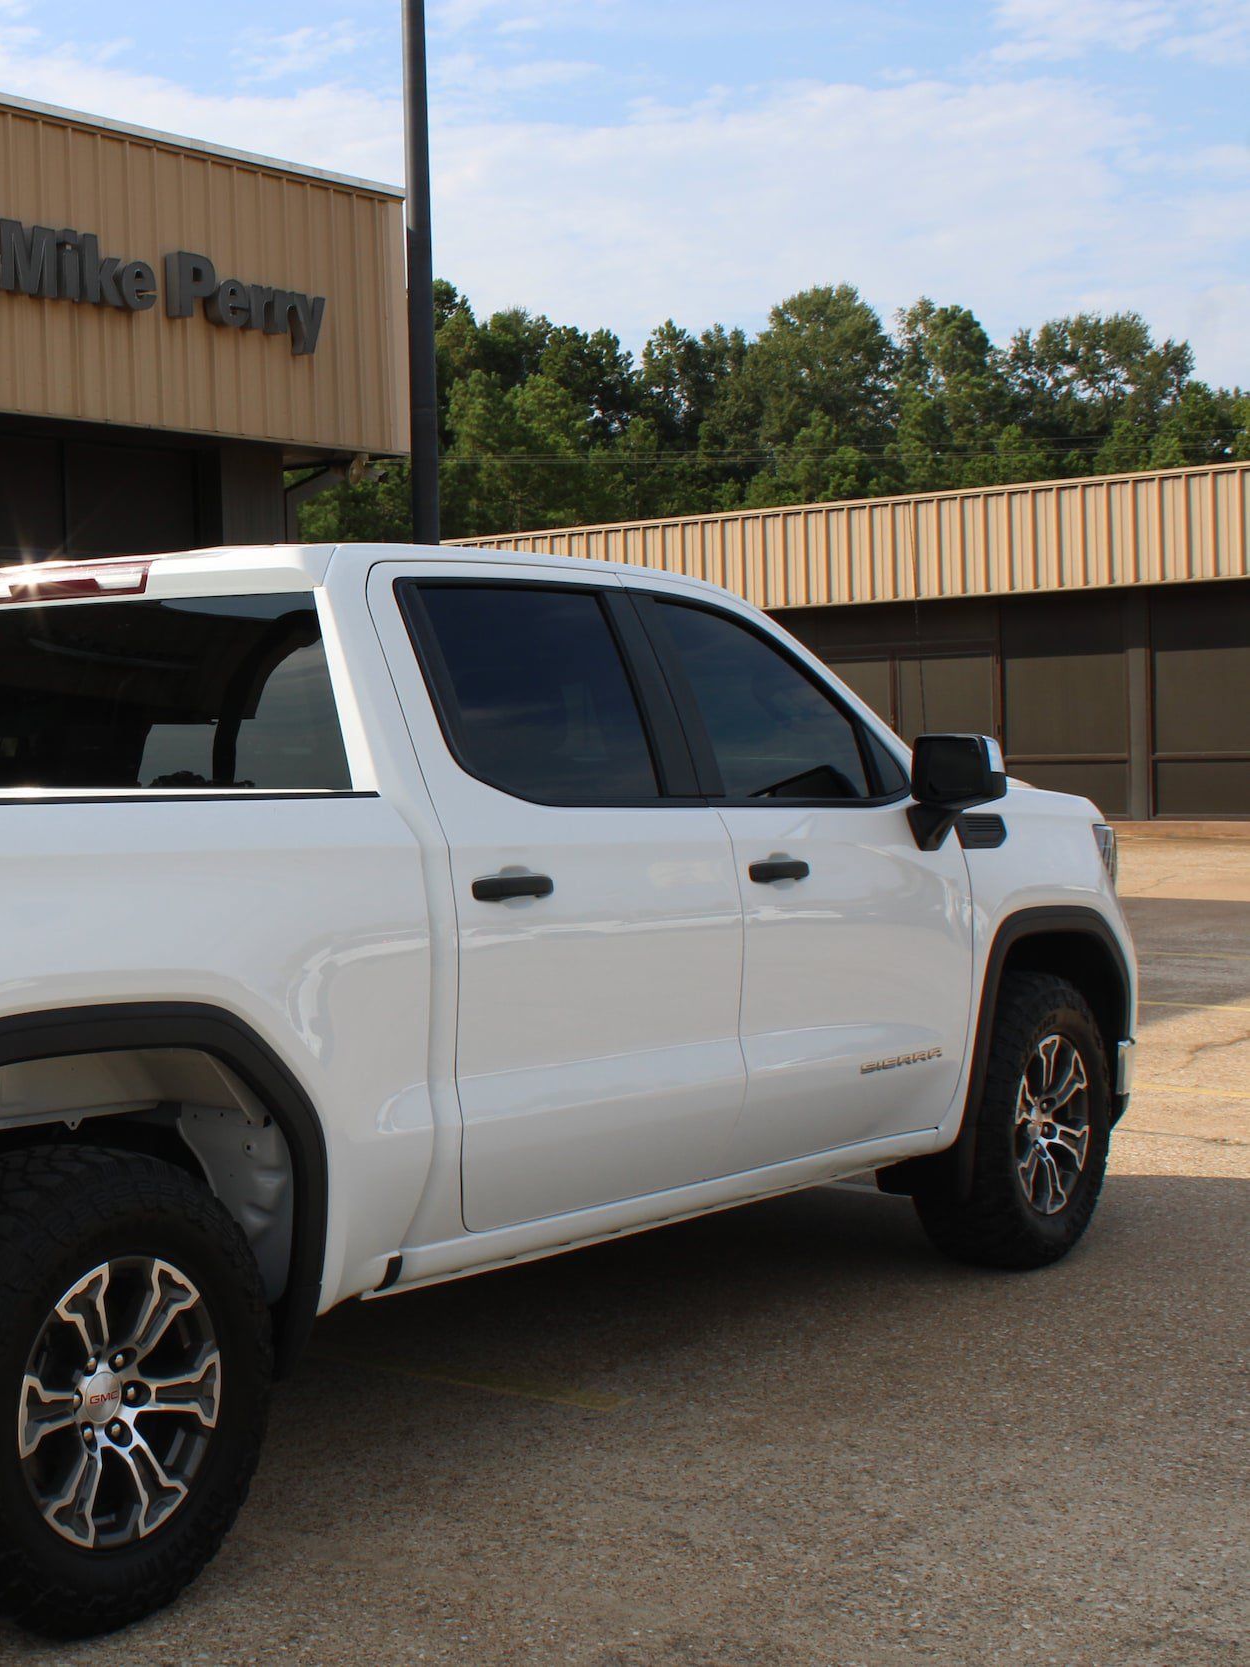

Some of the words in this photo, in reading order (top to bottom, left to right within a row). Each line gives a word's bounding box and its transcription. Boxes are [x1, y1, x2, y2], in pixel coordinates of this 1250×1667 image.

[164, 250, 325, 355] Perry
[860, 1046, 943, 1075] SIERRA
[89, 1390, 119, 1405] GMC
